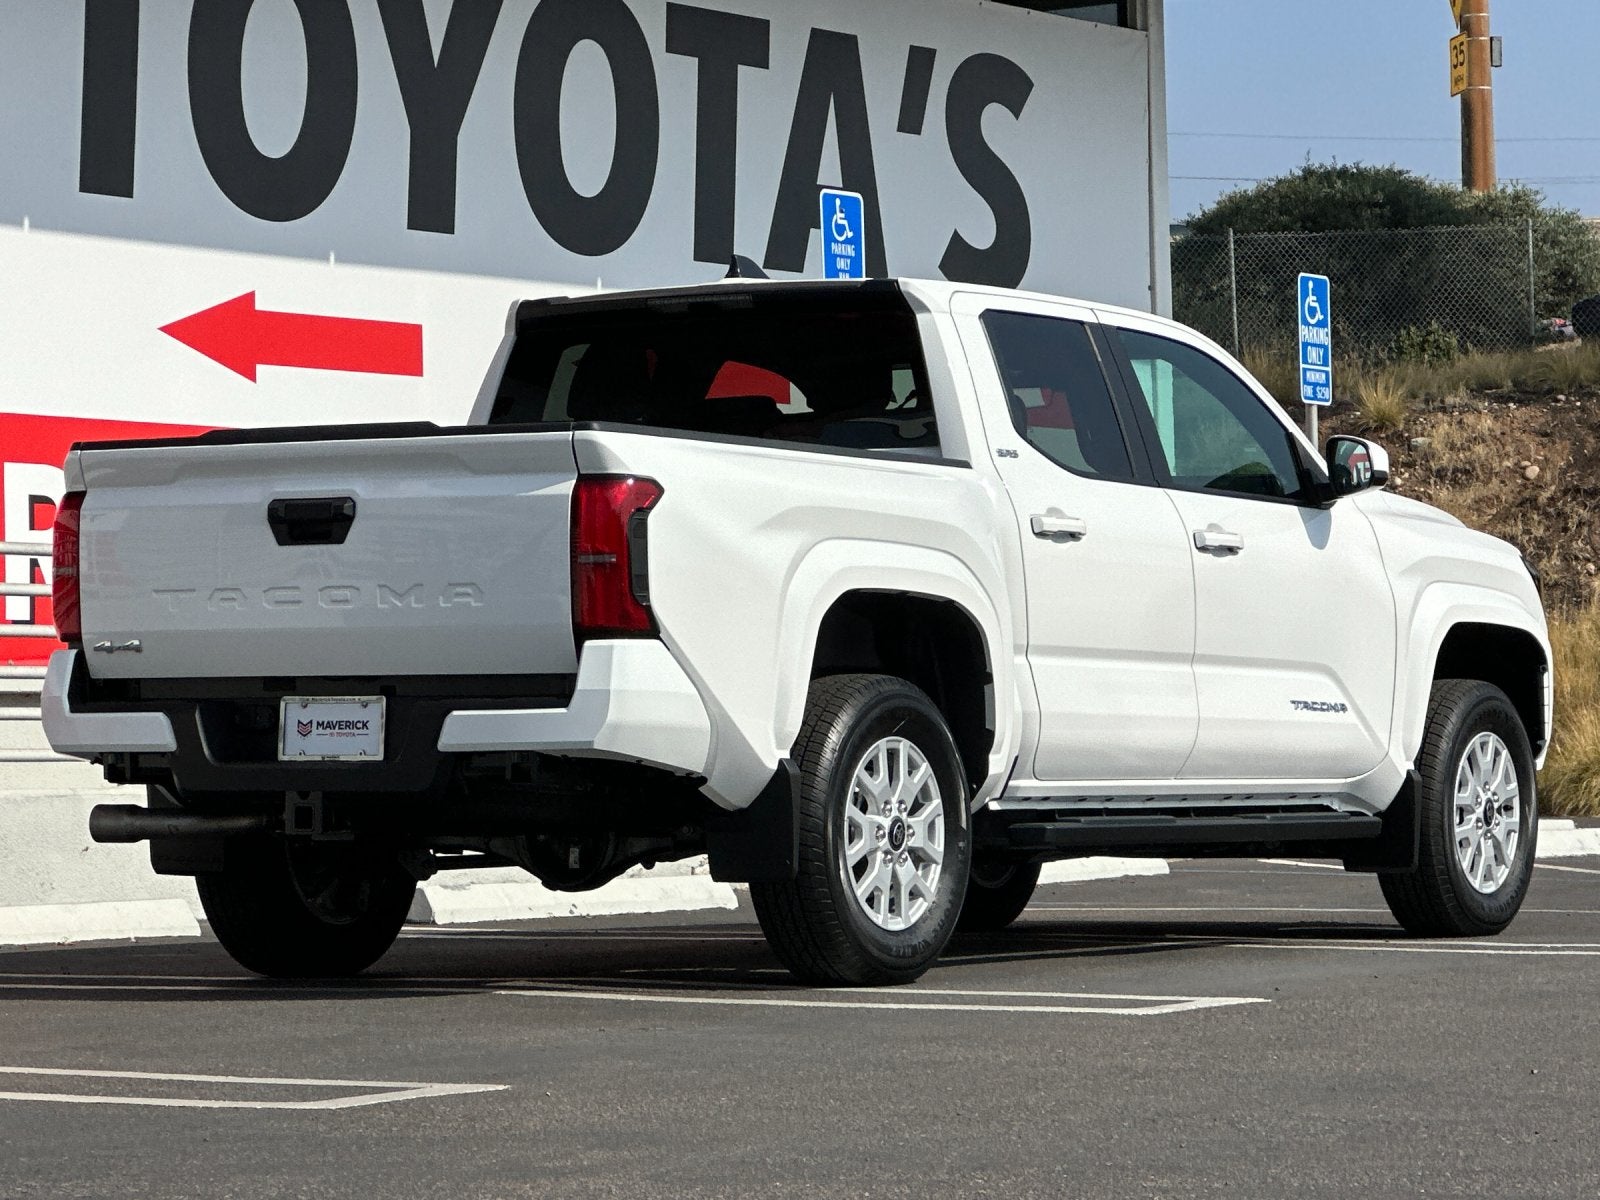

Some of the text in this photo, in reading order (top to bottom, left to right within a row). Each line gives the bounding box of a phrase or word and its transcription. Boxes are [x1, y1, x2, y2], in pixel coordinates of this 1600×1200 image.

[1452, 41, 1466, 69] 35
[831, 242, 856, 257] PARKING
[836, 257, 851, 270] ONLY
[1301, 325, 1329, 345] PARKING
[1307, 345, 1324, 364] ONLY
[1303, 384, 1314, 397] FINE
[153, 582, 485, 612] TACOMA
[1290, 700, 1348, 713] TACOMA
[316, 720, 369, 730] MAVERICK
